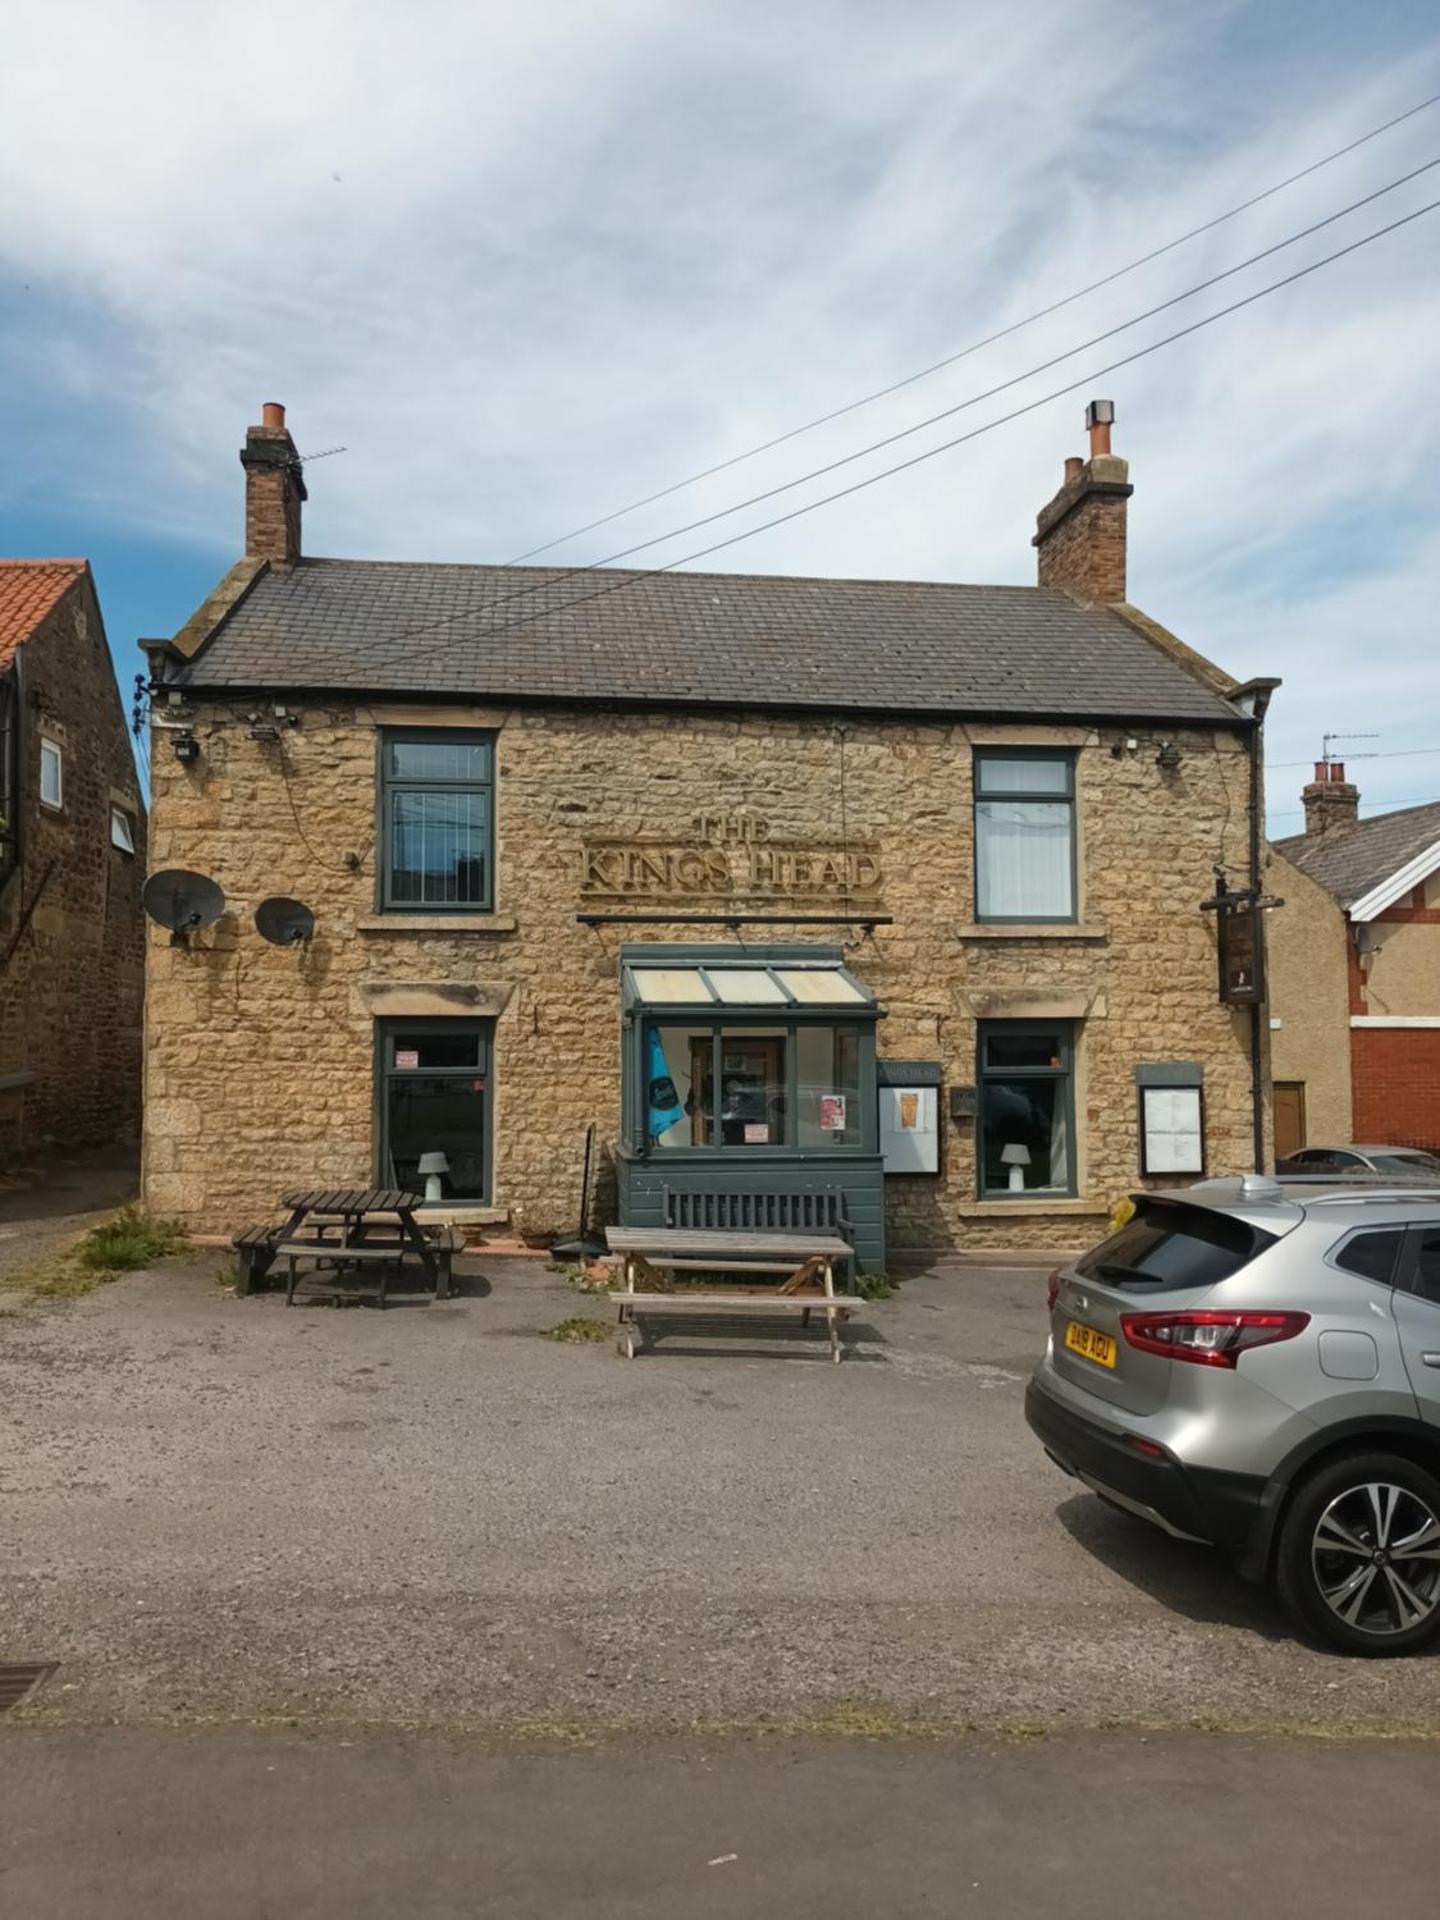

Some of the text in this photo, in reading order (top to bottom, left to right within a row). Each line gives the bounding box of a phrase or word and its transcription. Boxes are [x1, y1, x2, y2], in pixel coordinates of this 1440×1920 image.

[696, 814, 768, 842] THE
[581, 849, 881, 888] KINGS HEAD
